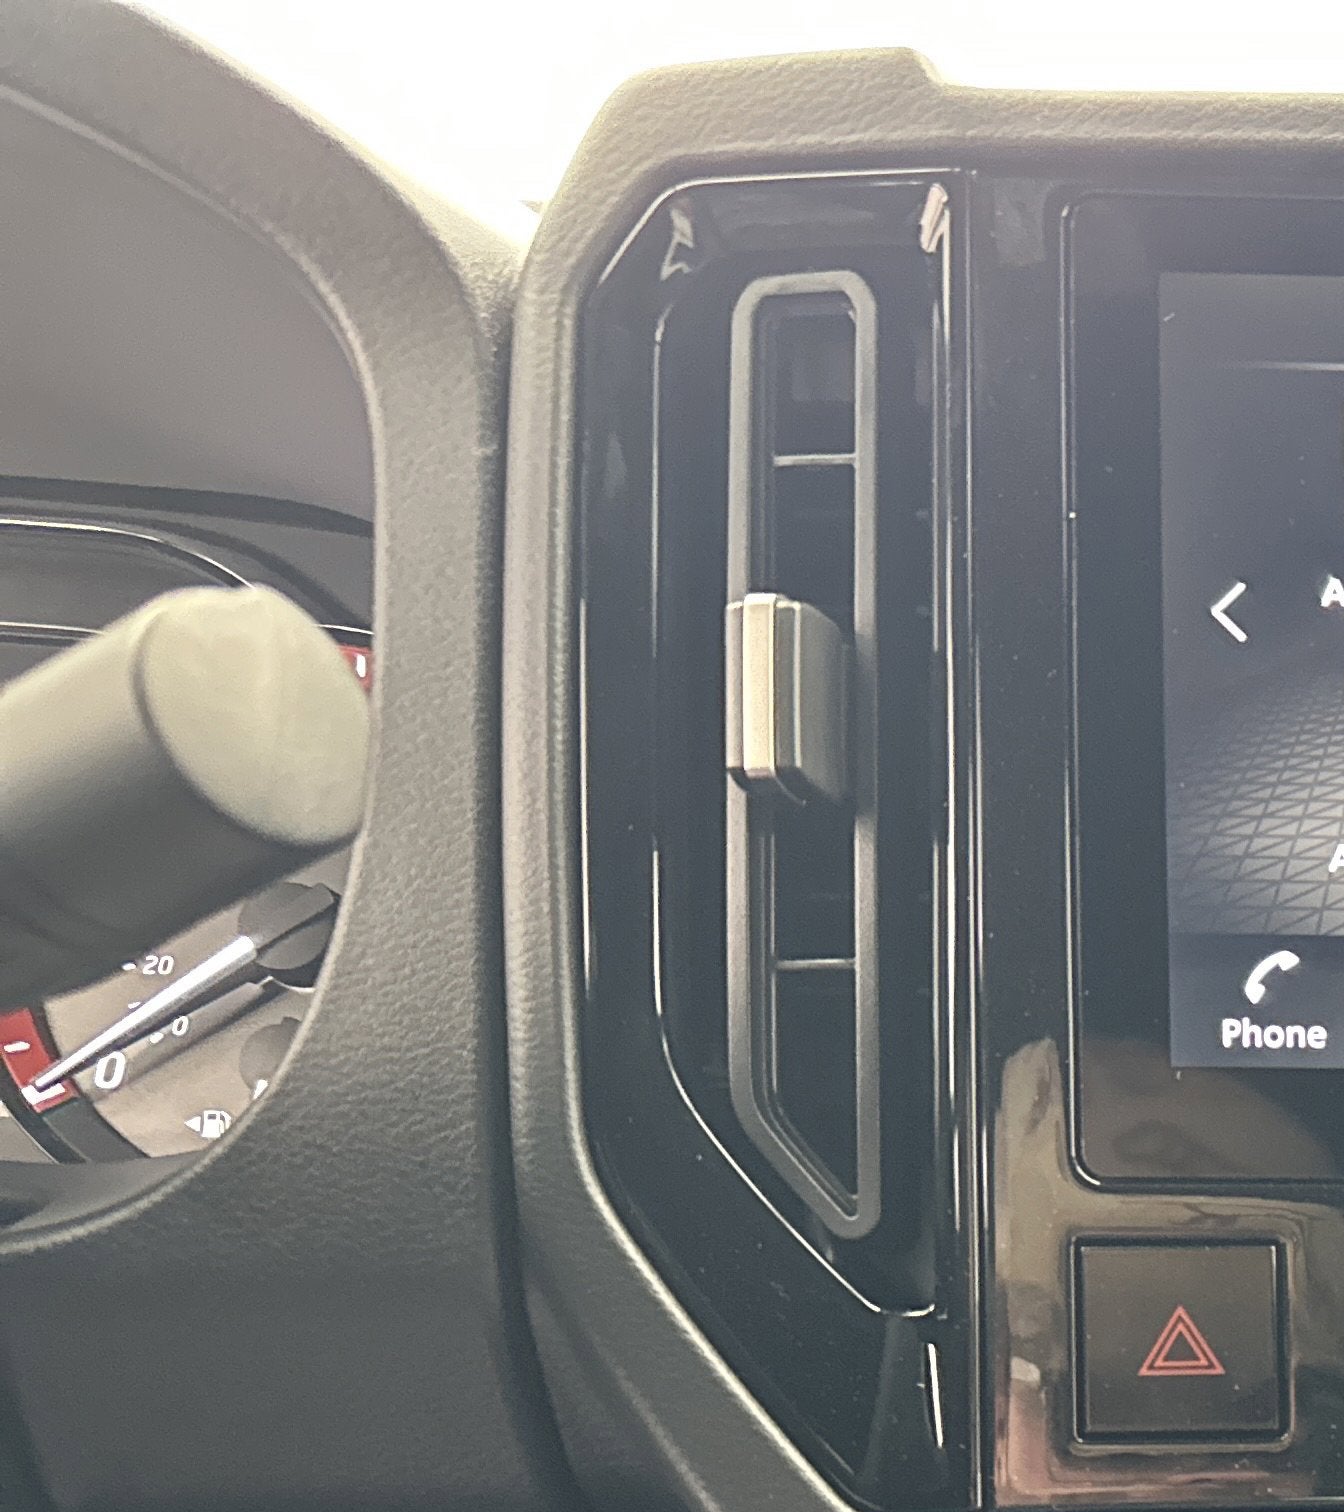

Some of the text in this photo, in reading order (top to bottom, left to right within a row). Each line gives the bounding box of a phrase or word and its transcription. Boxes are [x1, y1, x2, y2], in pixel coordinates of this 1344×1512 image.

[142, 955, 174, 975] 20
[1221, 1018, 1328, 1052] Phone
[94, 1051, 126, 1088] 0
